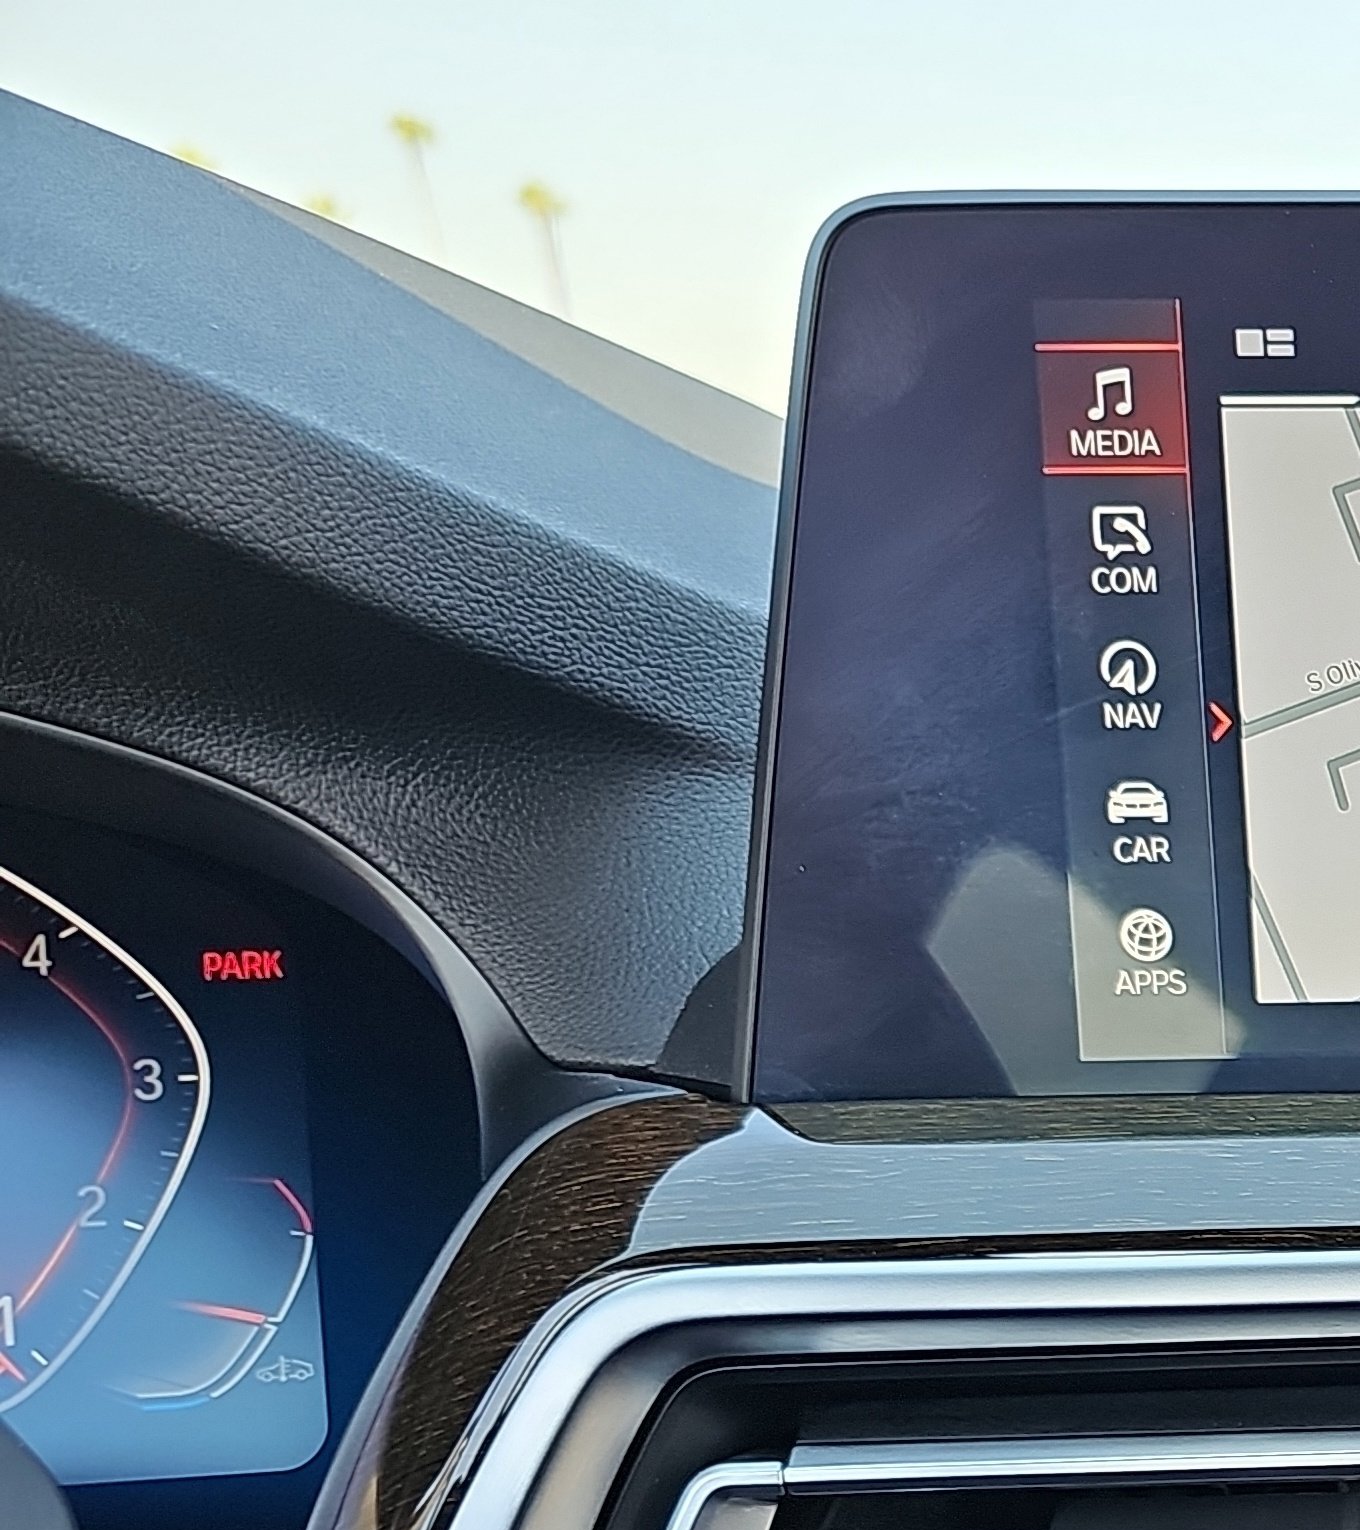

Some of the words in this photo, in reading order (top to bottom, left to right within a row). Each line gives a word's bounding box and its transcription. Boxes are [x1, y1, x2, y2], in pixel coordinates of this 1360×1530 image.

[1069, 429, 1161, 457] MEDIA
[1091, 567, 1157, 594] COM
[1307, 673, 1322, 692] S
[1103, 702, 1162, 730] NAV
[1112, 836, 1171, 864] CAR
[22, 934, 53, 976] 4
[202, 950, 285, 981] PARK
[1114, 969, 1187, 996] APPS
[133, 1058, 164, 1101] 3
[76, 1184, 108, 1229] 2
